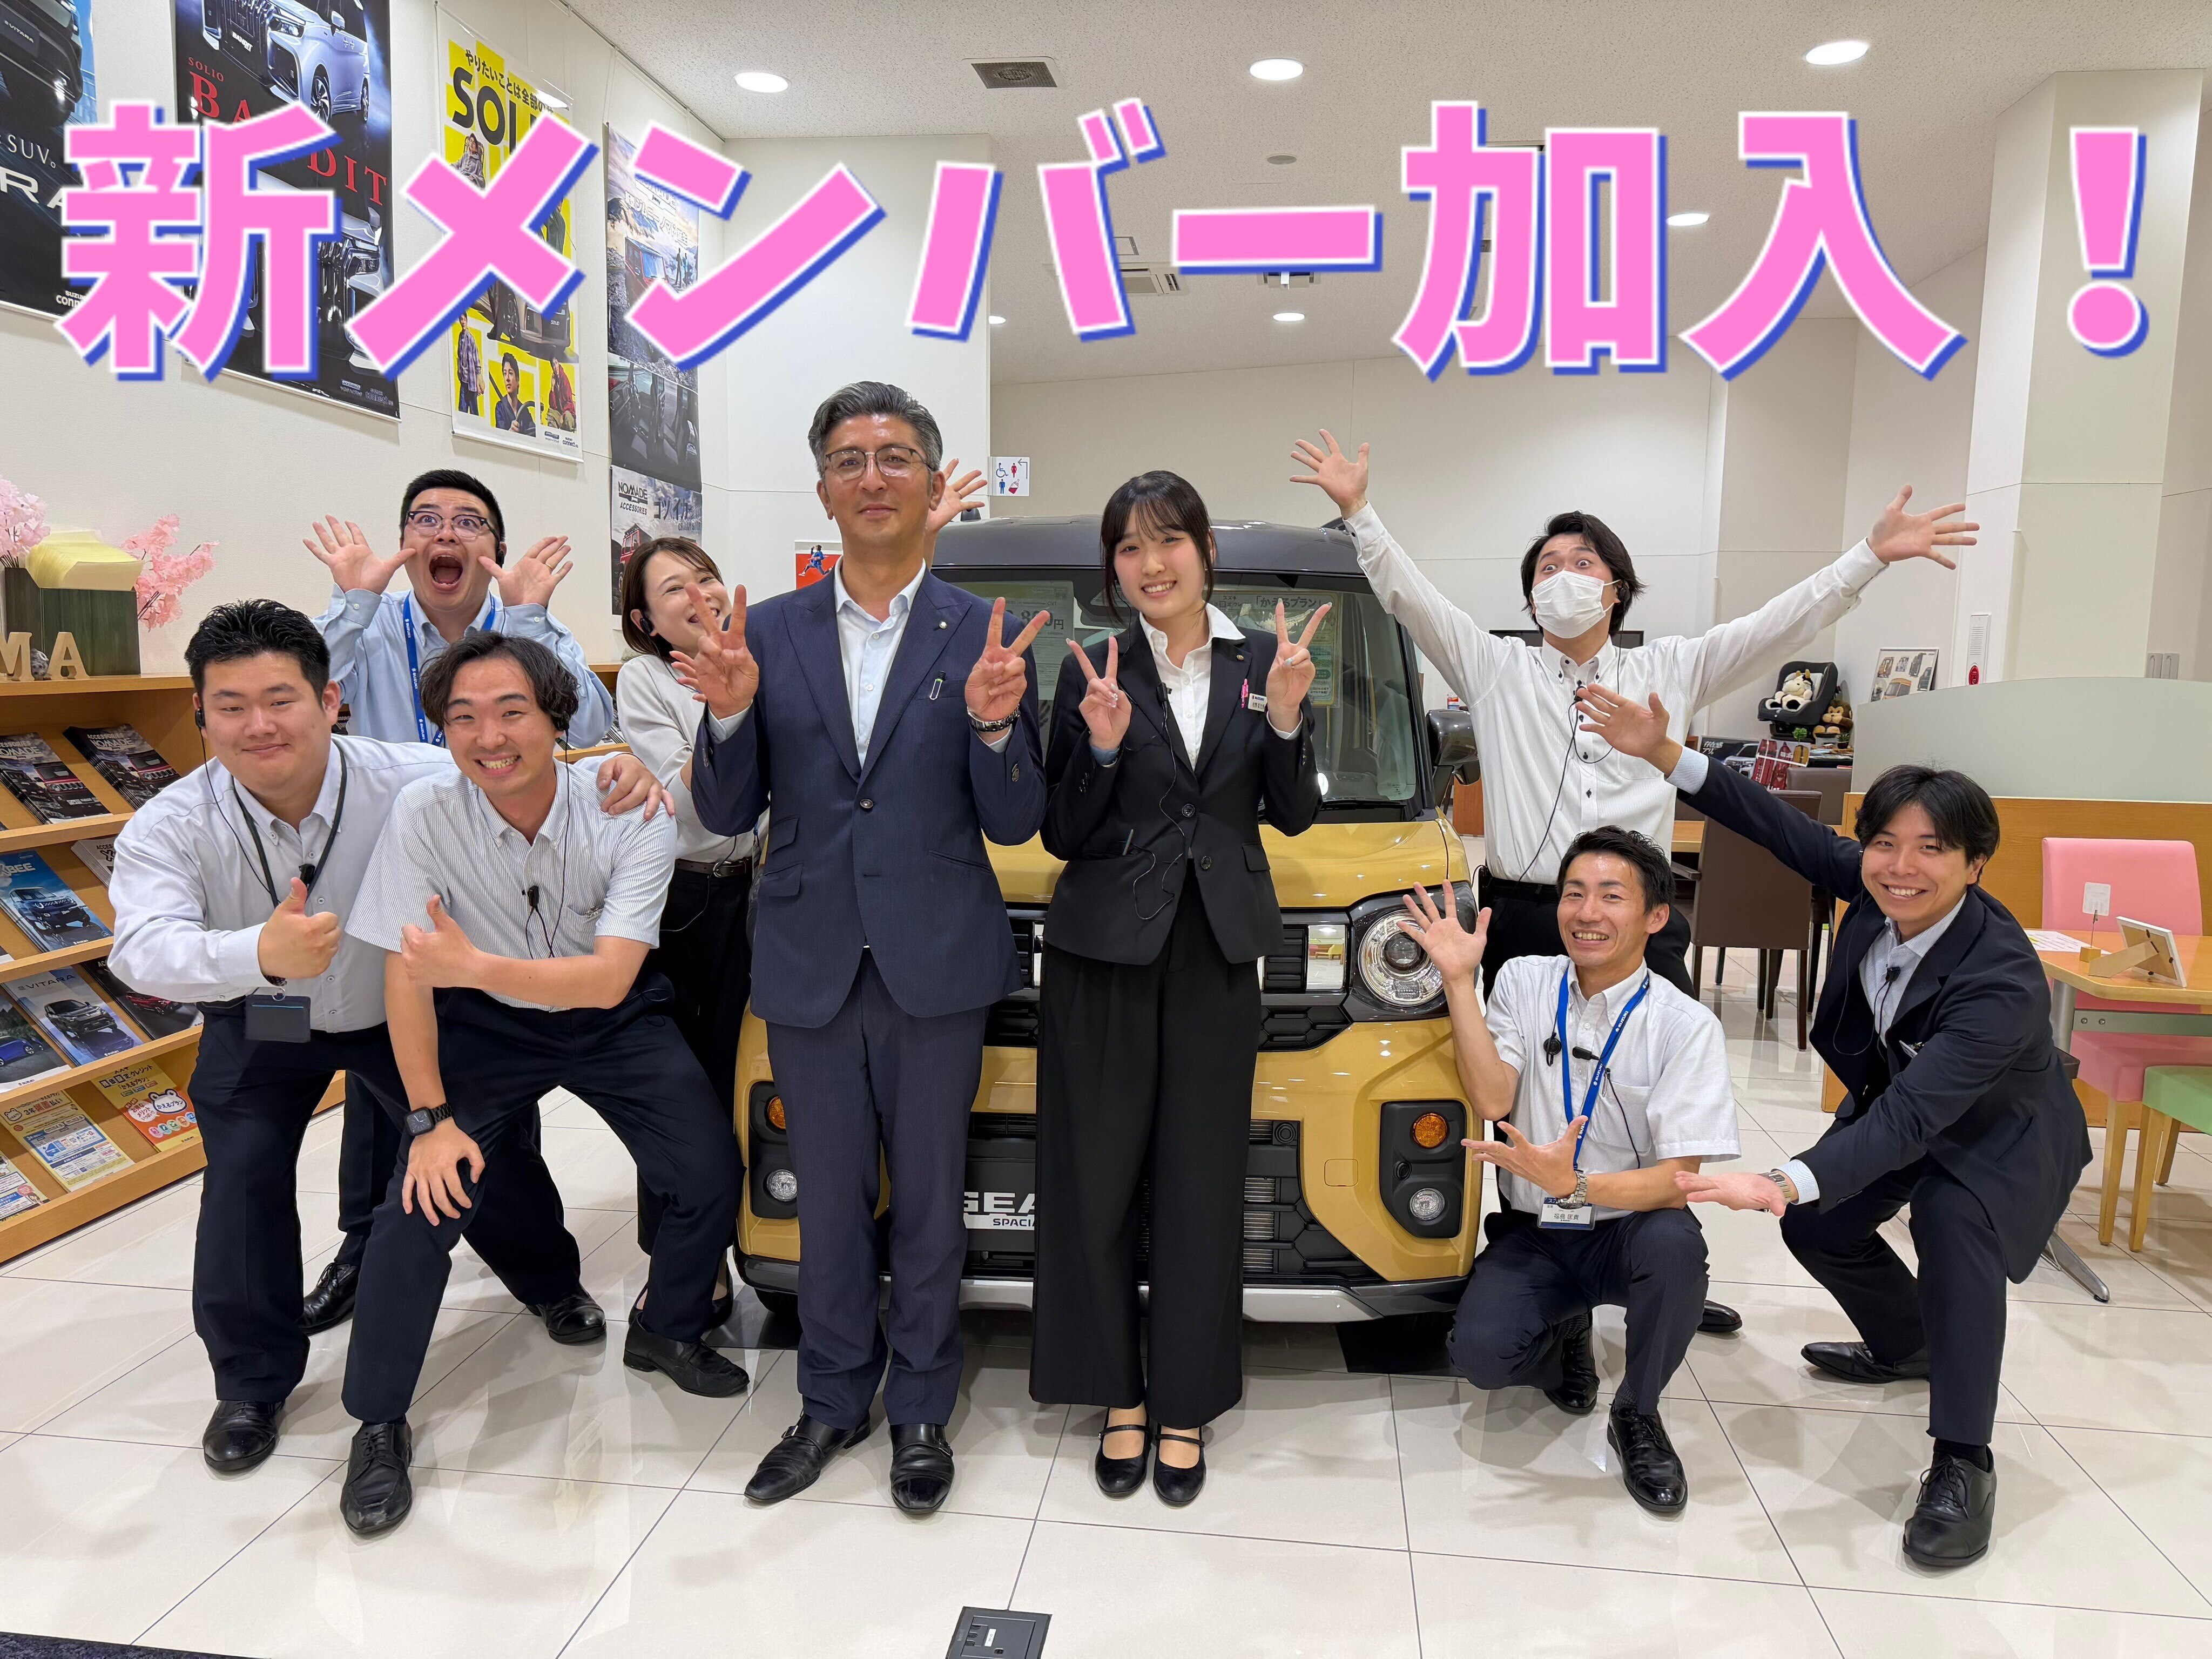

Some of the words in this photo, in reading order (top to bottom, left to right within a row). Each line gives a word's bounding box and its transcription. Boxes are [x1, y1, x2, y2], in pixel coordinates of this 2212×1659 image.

[188, 57, 224, 82] SOLIO
[190, 71, 387, 206] BADIT
[618, 481, 648, 500] NOMADE
[620, 502, 647, 515] ACCESSORIES
[90, 738, 134, 747] NOMADE
[1618, 1010, 1629, 1028] SUZUKI
[993, 1218, 1035, 1227] SPACI
